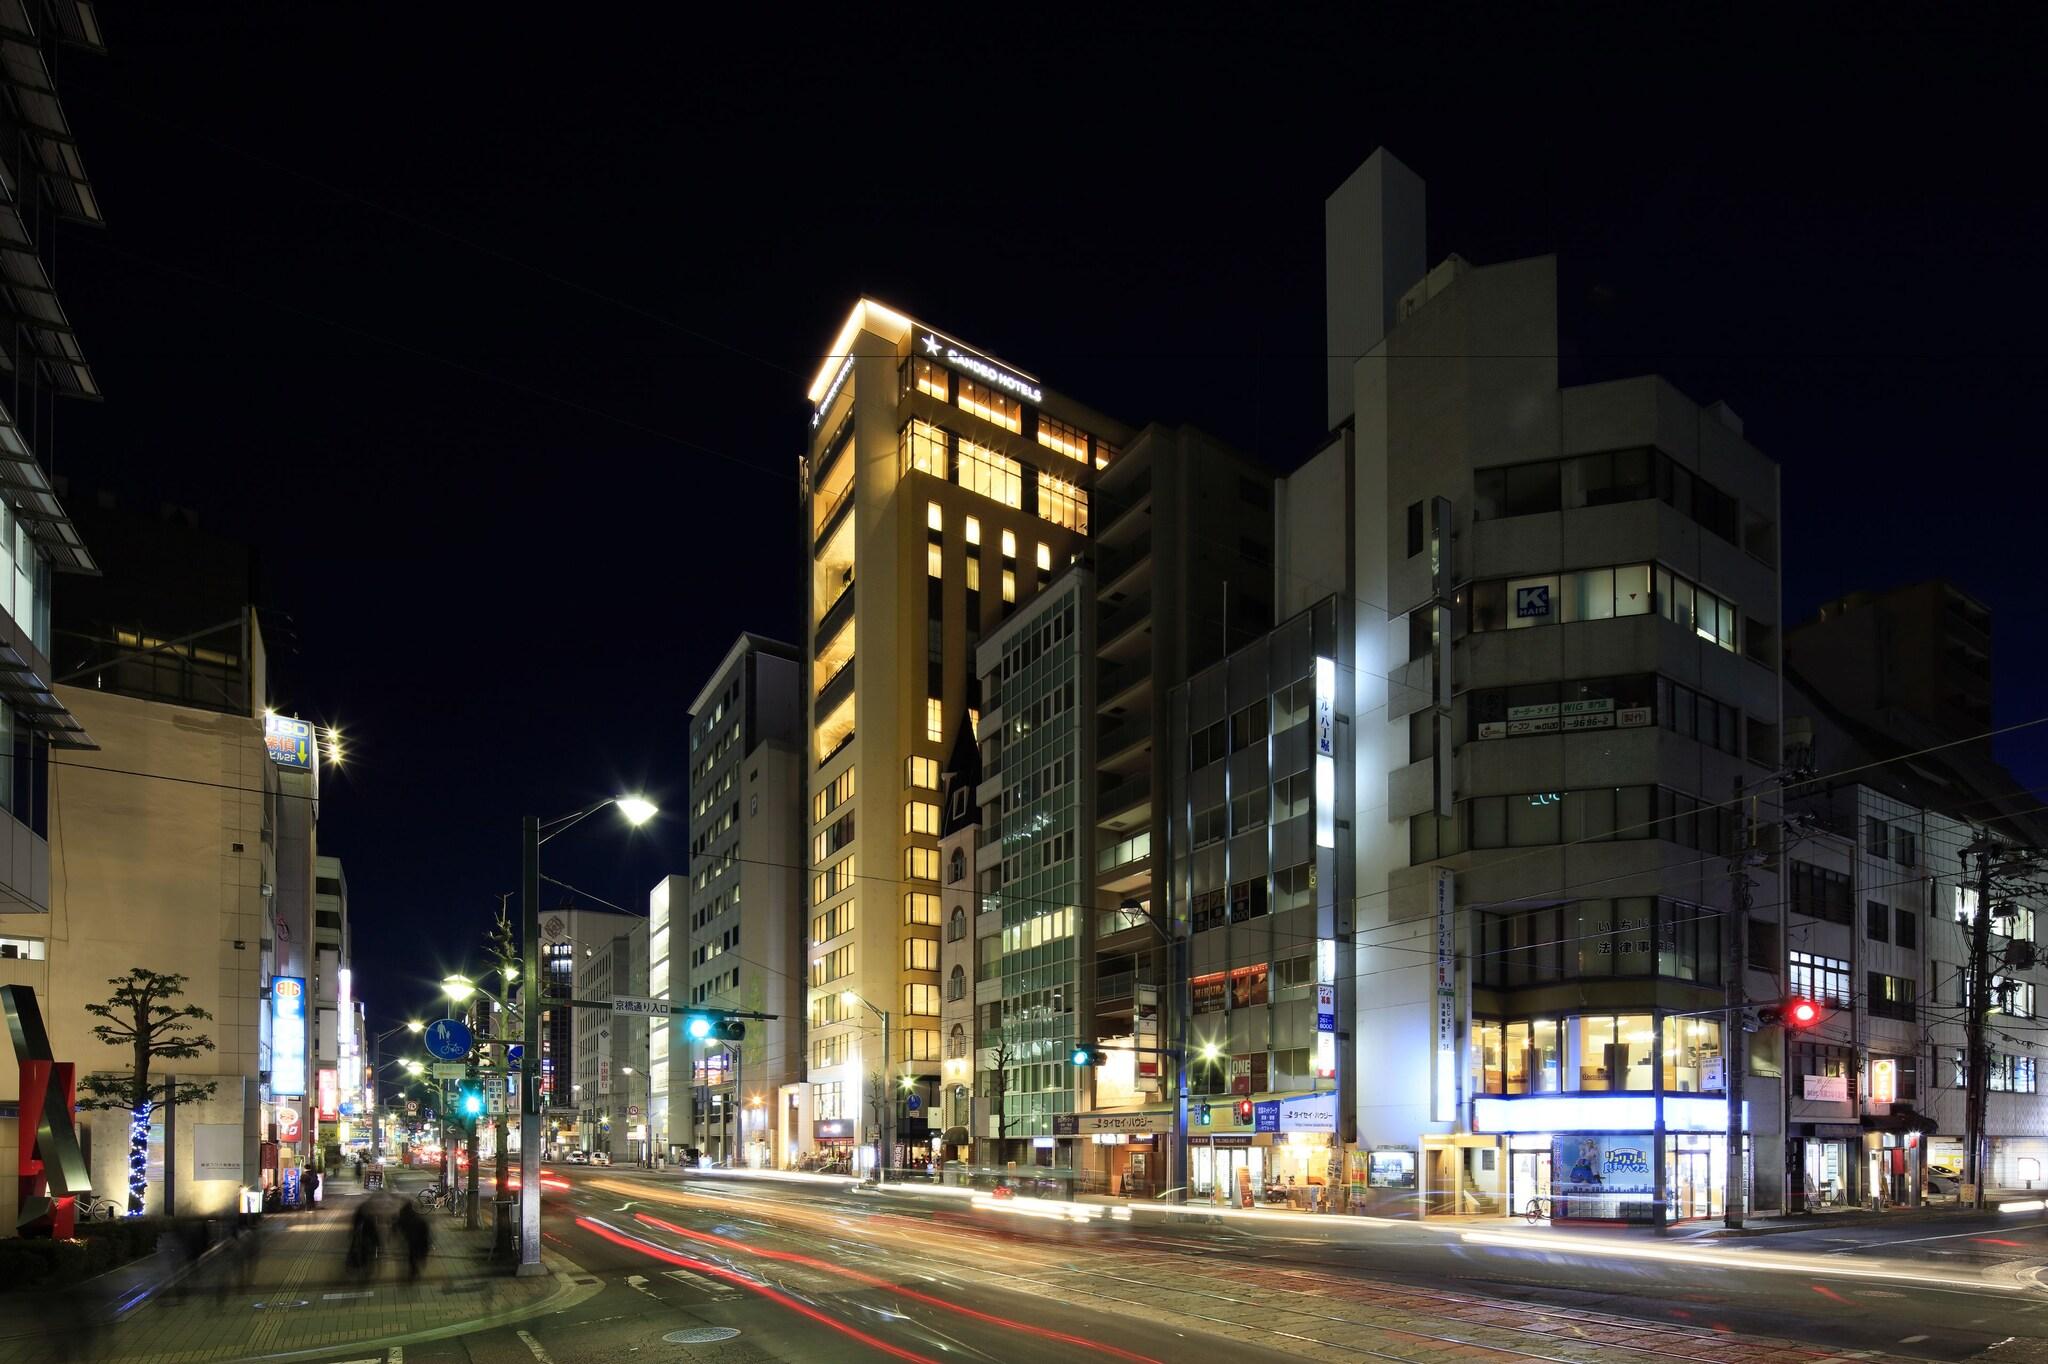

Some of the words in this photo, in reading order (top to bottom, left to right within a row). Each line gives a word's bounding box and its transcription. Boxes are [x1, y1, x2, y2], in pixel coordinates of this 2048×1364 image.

[947, 349, 997, 381] CANDEO
[998, 373, 1042, 402] HOTELS
[1519, 607, 1546, 616] HAIR
[277, 982, 300, 997] BIG
[615, 1000, 668, 1014] 京橋通り入口
[1293, 1110, 1334, 1120] タイセイ・ハウジー
[1103, 1117, 1153, 1128] タイセイ・ハウジー
[1603, 1161, 1649, 1173] 良和ハウス
